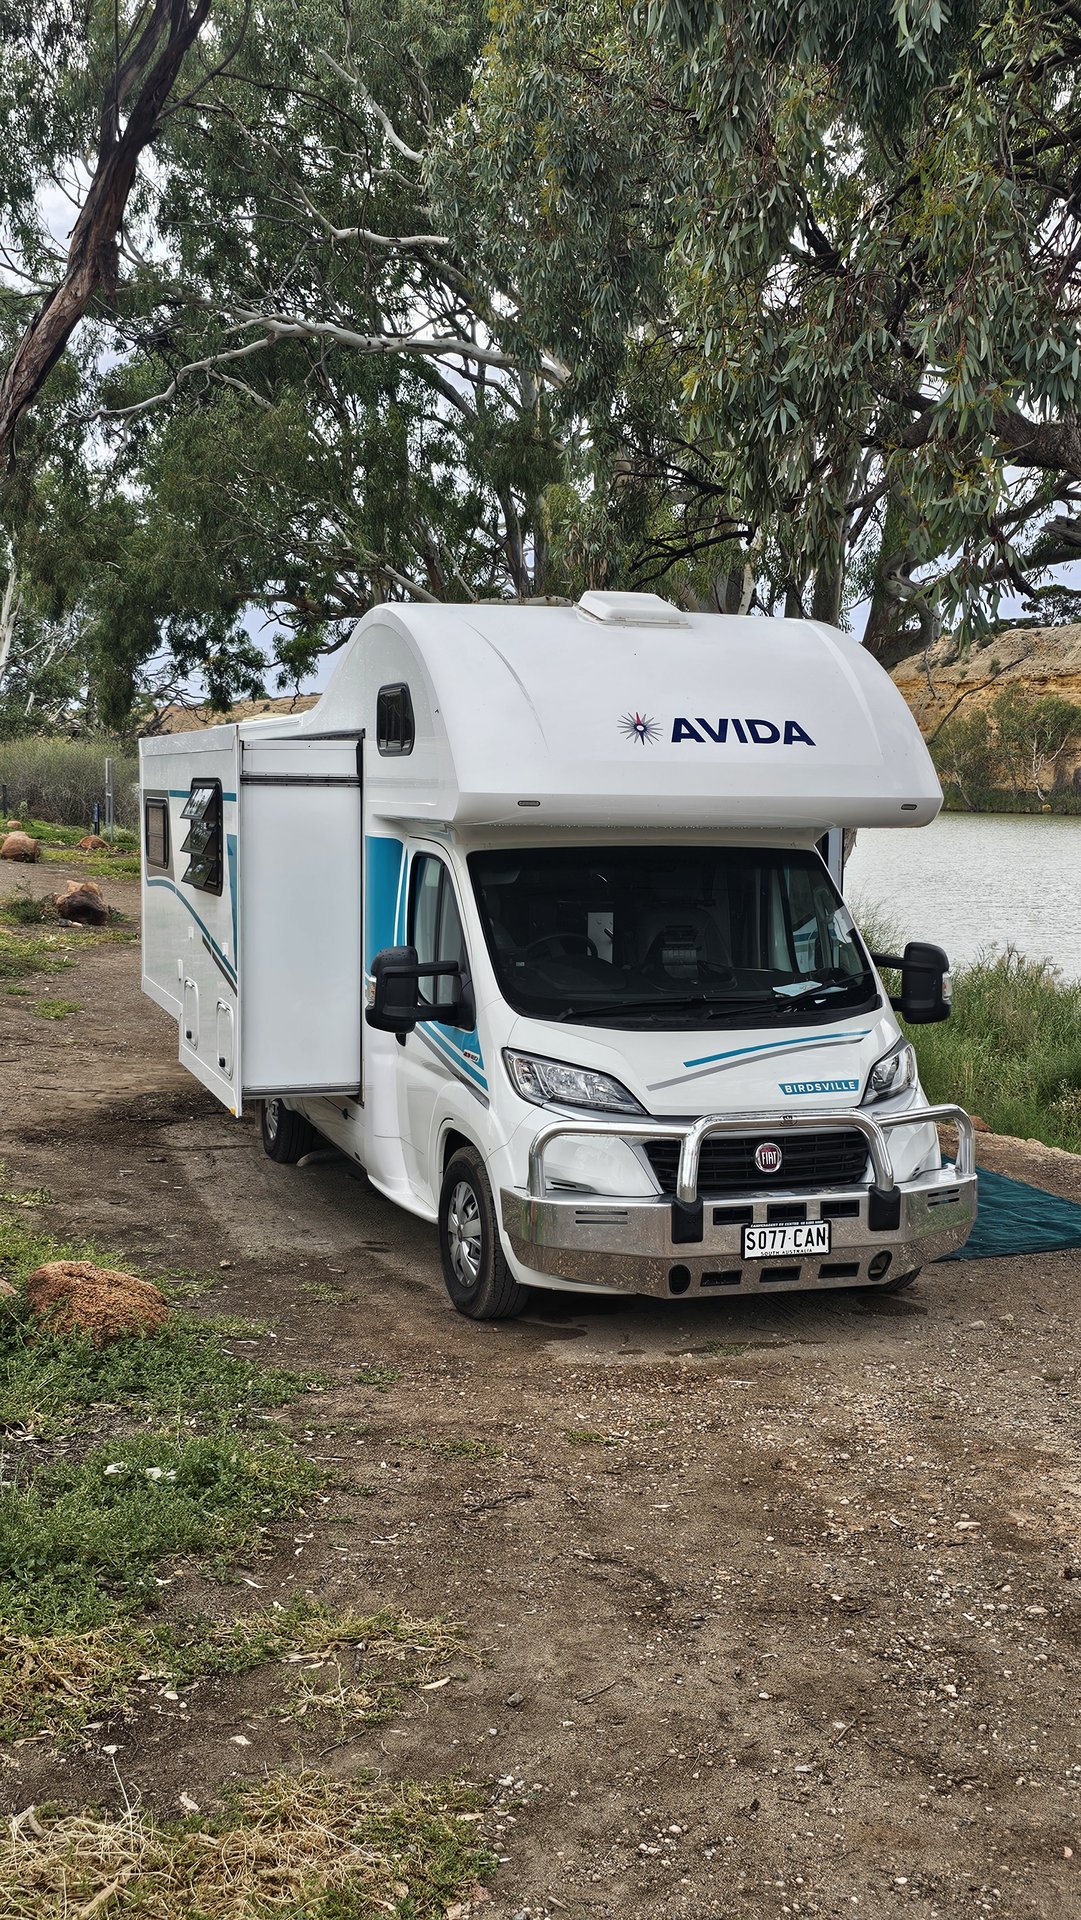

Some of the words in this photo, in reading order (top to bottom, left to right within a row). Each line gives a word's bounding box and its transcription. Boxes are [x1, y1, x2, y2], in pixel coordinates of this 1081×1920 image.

[671, 717, 816, 746] AVIDA
[785, 1081, 855, 1093] BIRDSVILLE
[761, 1151, 777, 1165] FIAT
